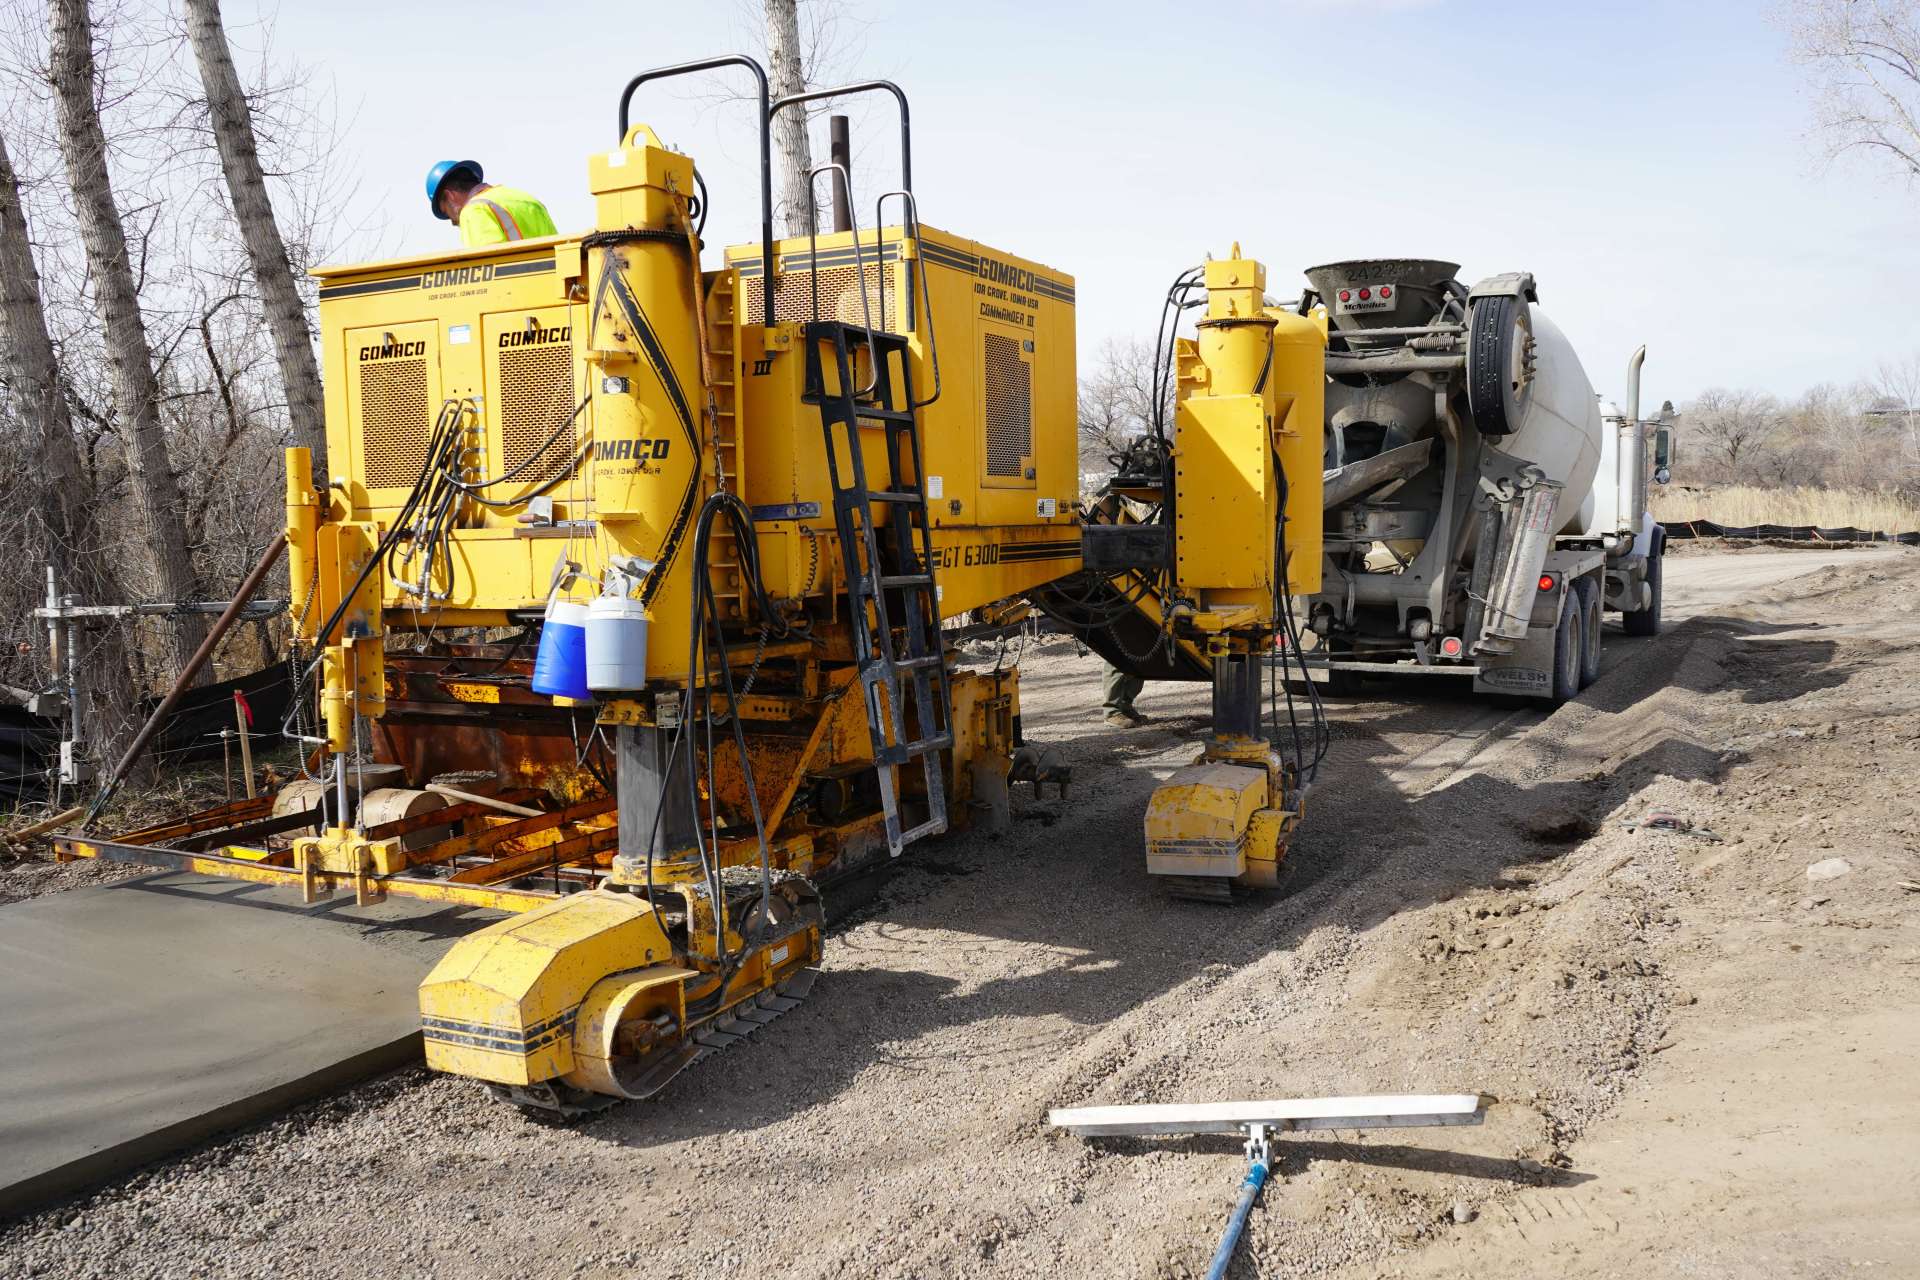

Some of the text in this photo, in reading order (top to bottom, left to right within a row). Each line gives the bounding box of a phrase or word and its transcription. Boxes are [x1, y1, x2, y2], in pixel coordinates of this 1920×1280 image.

[421, 264, 494, 289] GOMACO
[979, 256, 1035, 293] GOMACO
[980, 302, 1025, 326] COMMANDER
[1027, 297, 1039, 310] USA
[499, 326, 572, 347] GOMACO
[359, 341, 426, 361] GOMACO
[594, 439, 670, 461] OMACO
[943, 543, 999, 569] GT 6300
